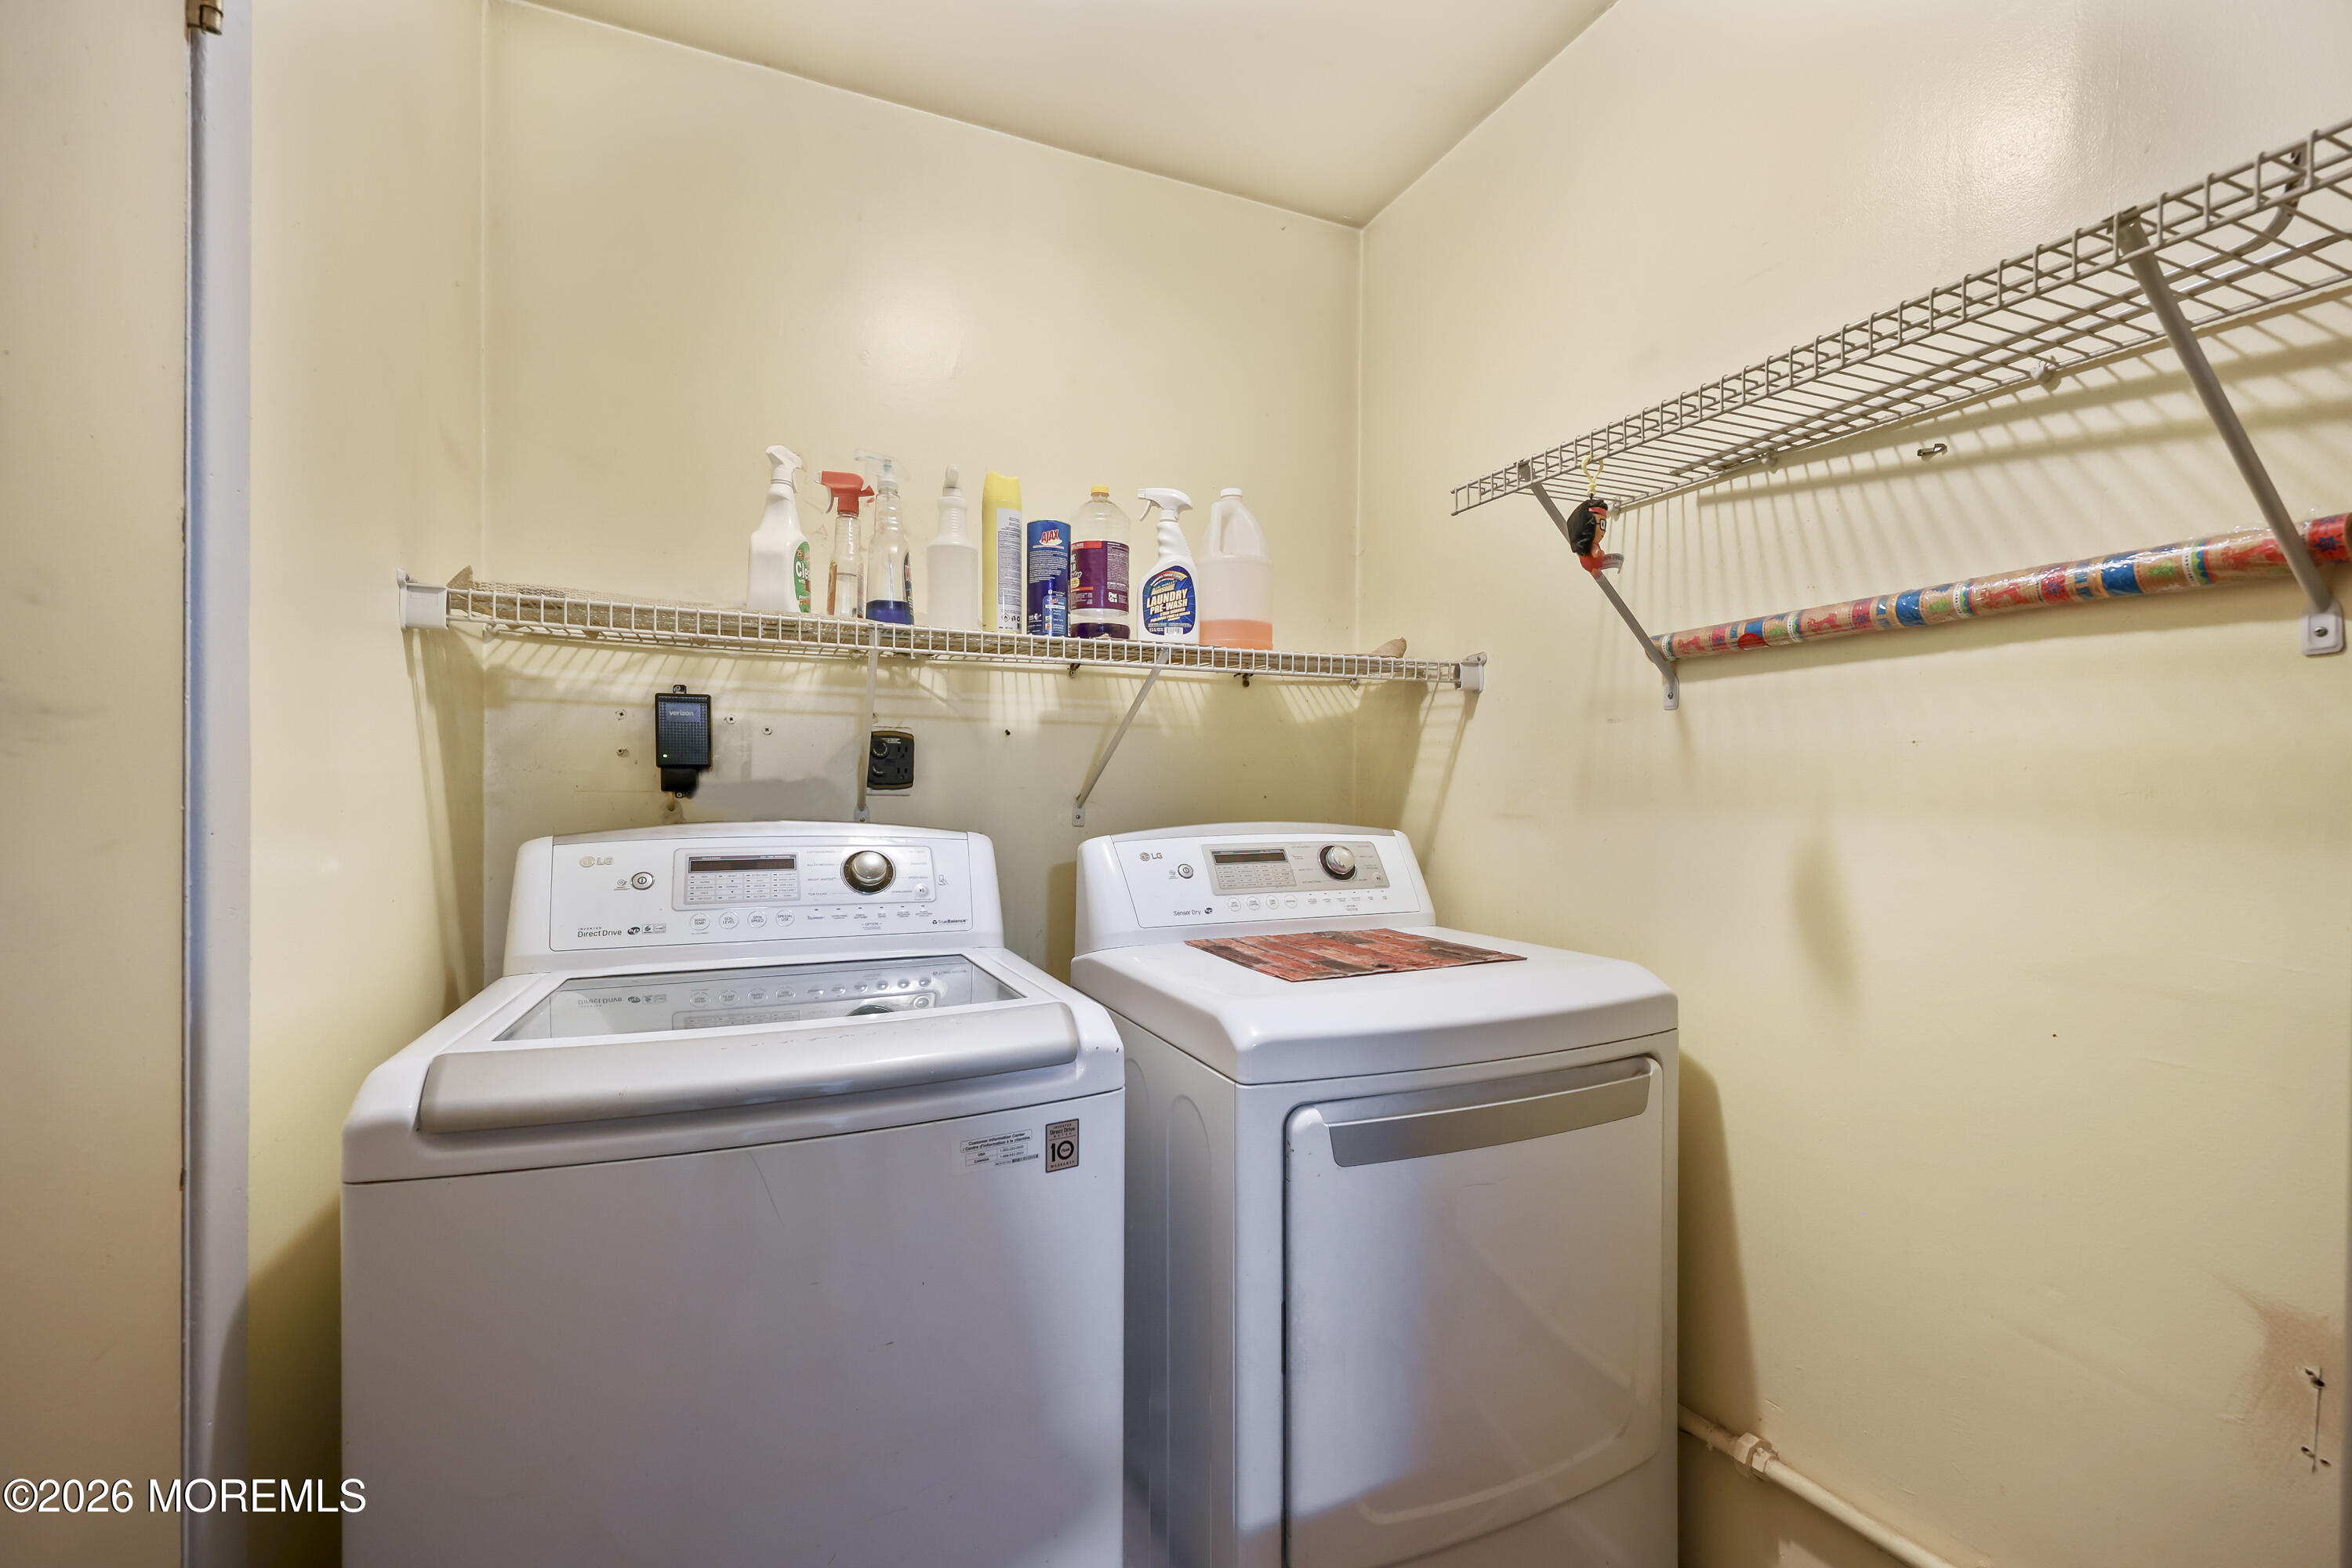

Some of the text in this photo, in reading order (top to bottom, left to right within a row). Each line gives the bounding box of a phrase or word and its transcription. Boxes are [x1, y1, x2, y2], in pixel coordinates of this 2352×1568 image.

[1040, 529, 1060, 543] AJAX
[1146, 589, 1189, 608] LAUNDRY
[1149, 598, 1189, 615] PRE-WASH
[597, 857, 614, 866] LG
[1050, 1140, 1075, 1163] 10
